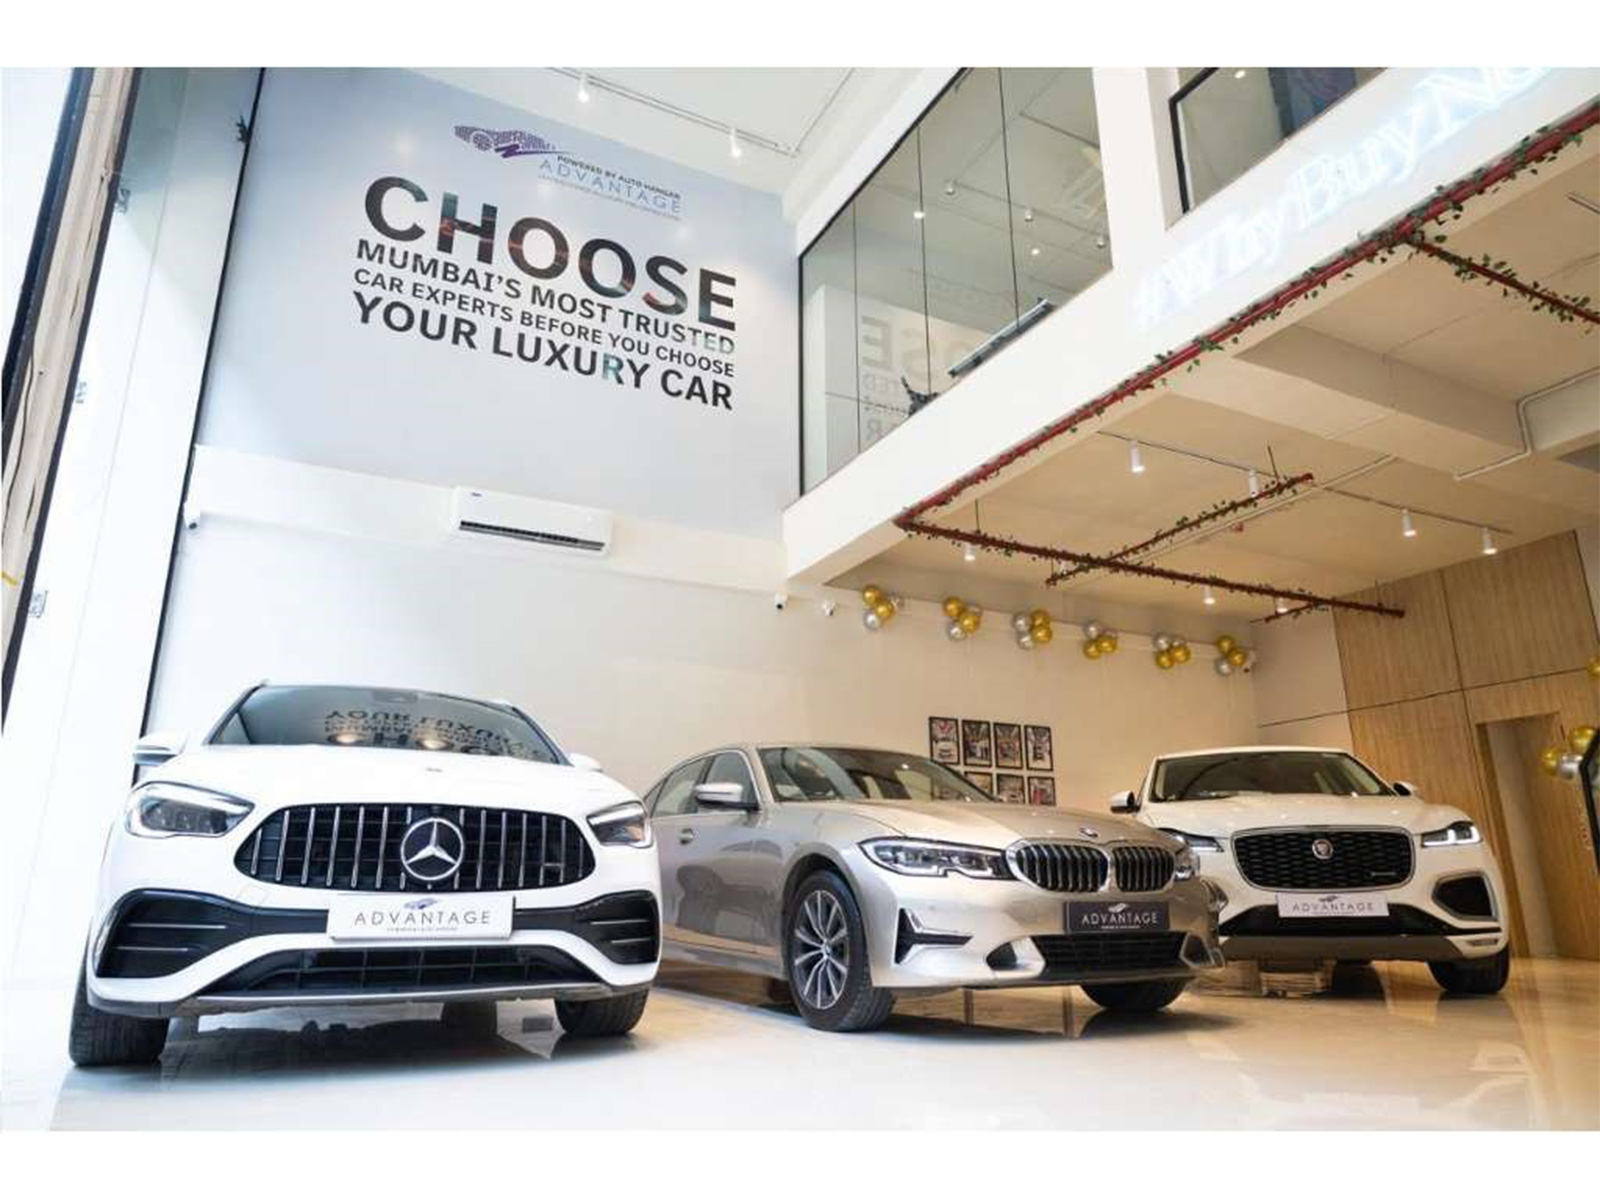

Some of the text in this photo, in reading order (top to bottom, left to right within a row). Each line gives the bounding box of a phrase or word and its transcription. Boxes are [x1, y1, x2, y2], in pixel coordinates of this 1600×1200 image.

[540, 159, 681, 213] ADVANTAGE
[557, 155, 603, 175] POWERED
[604, 169, 617, 178] BY
[618, 175, 642, 187] AUTO
[364, 176, 737, 331] CHOOSE
[353, 268, 735, 378] CAR EXPERTS BEFORE YOU CHOOSE
[356, 238, 736, 356] MUMBAI'S MOST TRUSTED
[353, 290, 733, 411] YOUR LUXURY CAR
[354, 910, 491, 926] ADVANTAGE
[1081, 911, 1158, 926] ADVANTAGE
[1292, 902, 1375, 912] ADVANTAGE
